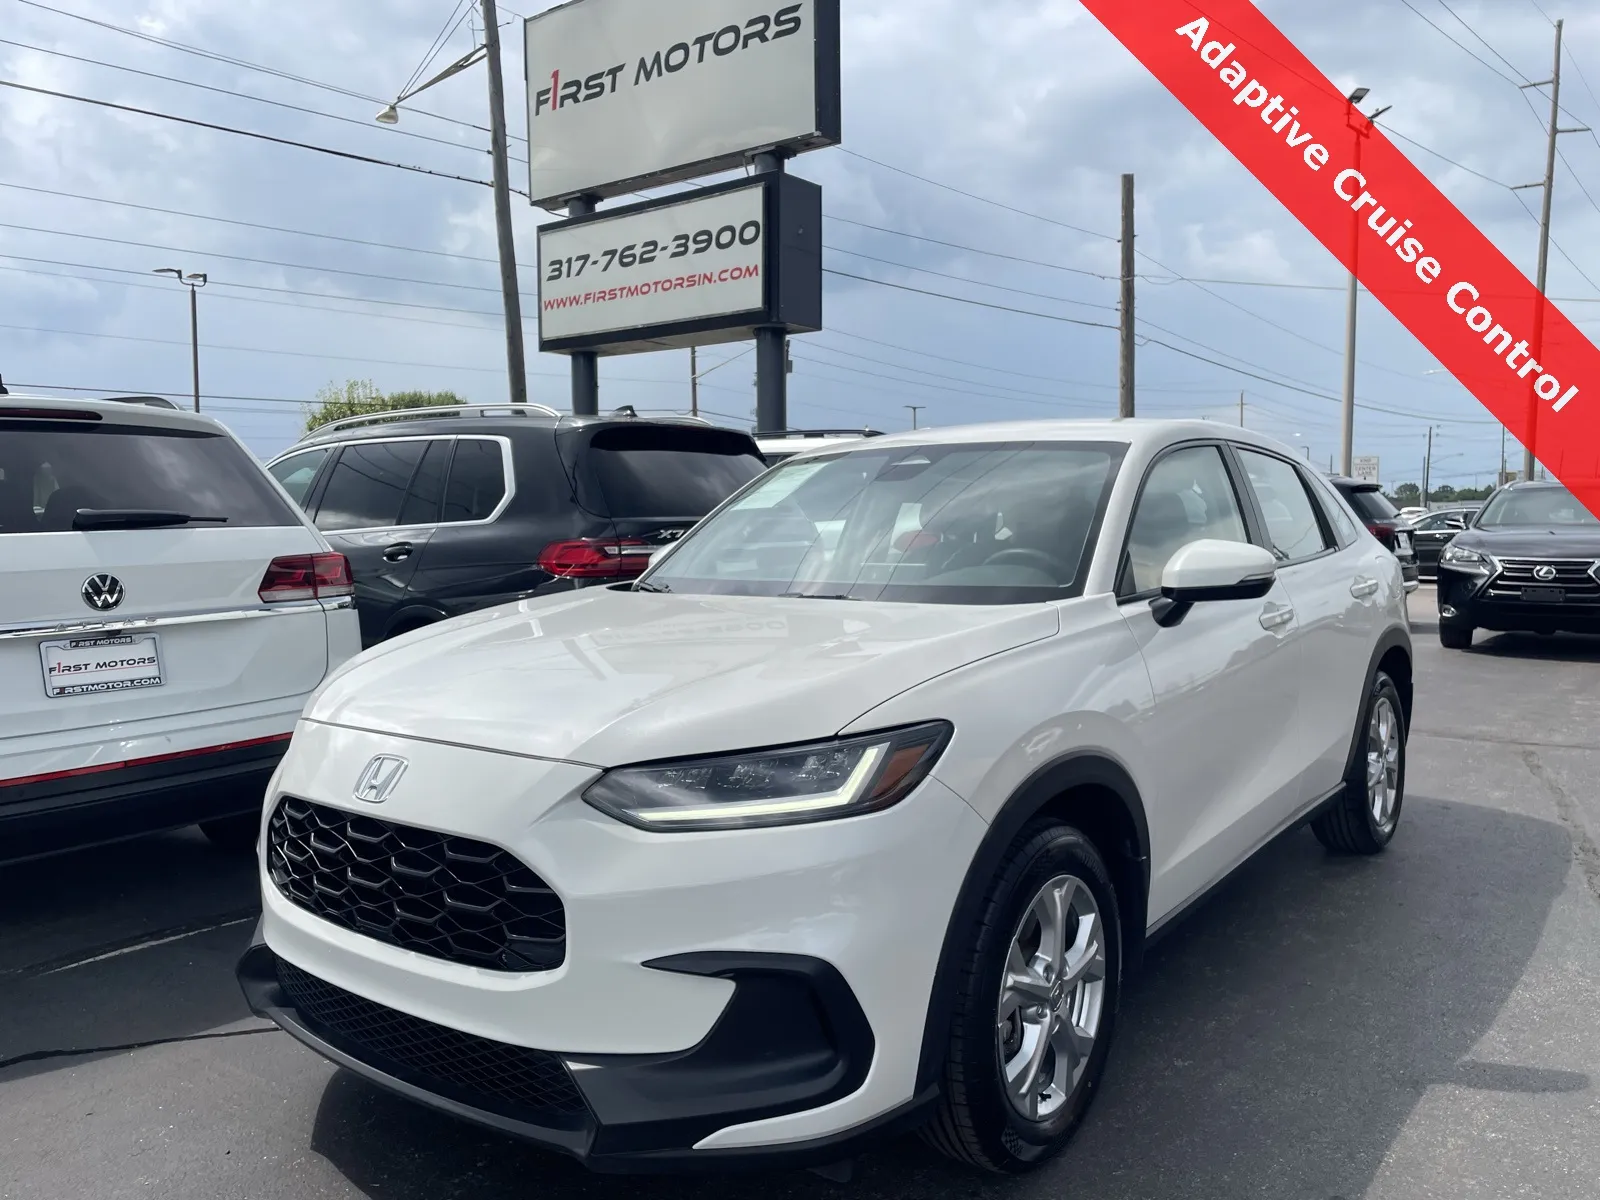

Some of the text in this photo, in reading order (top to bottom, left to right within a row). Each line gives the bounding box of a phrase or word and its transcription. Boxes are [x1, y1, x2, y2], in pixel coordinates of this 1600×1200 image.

[633, 3, 803, 86] MOTORS
[546, 220, 760, 282] 317-762-3900
[543, 264, 759, 311] WWW.FIRSTMOTORSIN.COM
[657, 529, 685, 539] X7
[71, 637, 132, 648] FRST MOTORS
[95, 656, 156, 669] MOTORS
